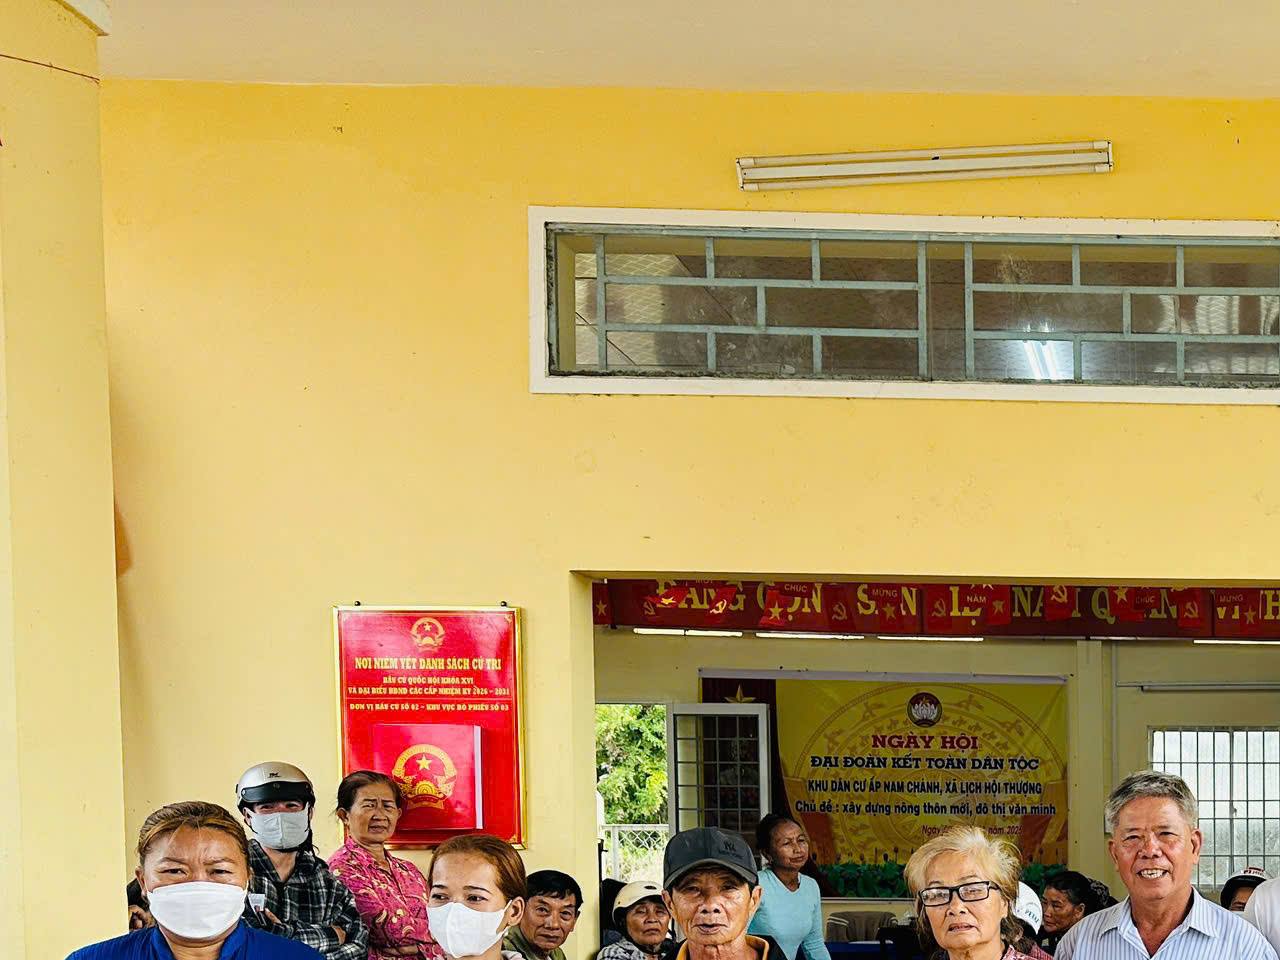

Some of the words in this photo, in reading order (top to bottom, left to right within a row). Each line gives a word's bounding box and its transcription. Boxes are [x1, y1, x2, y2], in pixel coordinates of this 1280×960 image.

[856, 583, 918, 616] SN
[419, 658, 445, 670] DANH
[447, 656, 470, 670] SÁCH
[486, 658, 501, 670] TRI
[872, 731, 934, 749] NGÀY
[941, 732, 978, 753] HỘI
[811, 755, 839, 770] ĐẠI
[843, 753, 887, 768] ĐOÀN
[892, 752, 922, 769] KẾT
[926, 754, 967, 769] TOÀN
[971, 755, 1004, 769] DÂN
[1008, 755, 1039, 772] TỘC
[808, 779, 828, 792] KHU
[831, 777, 851, 792] DÂN
[853, 778, 867, 792] CƯ
[869, 775, 881, 792] ẤP
[884, 781, 905, 793] NAM
[907, 777, 943, 796] CHÁNH,
[945, 778, 957, 793] XÃ
[961, 781, 981, 797] LỊCH
[985, 779, 1000, 797] HỘI
[1004, 780, 1041, 797] THƯỢNG
[796, 799, 816, 812] Chủ
[819, 798, 832, 812] đề
[843, 801, 860, 815] xây
[865, 802, 891, 817] dựng
[895, 801, 920, 815] nông
[923, 802, 946, 814] thôn
[950, 803, 973, 816] mới,
[976, 802, 988, 814] đô
[992, 803, 1006, 817] thị
[1009, 803, 1027, 815] văn
[1031, 803, 1056, 815] minh
